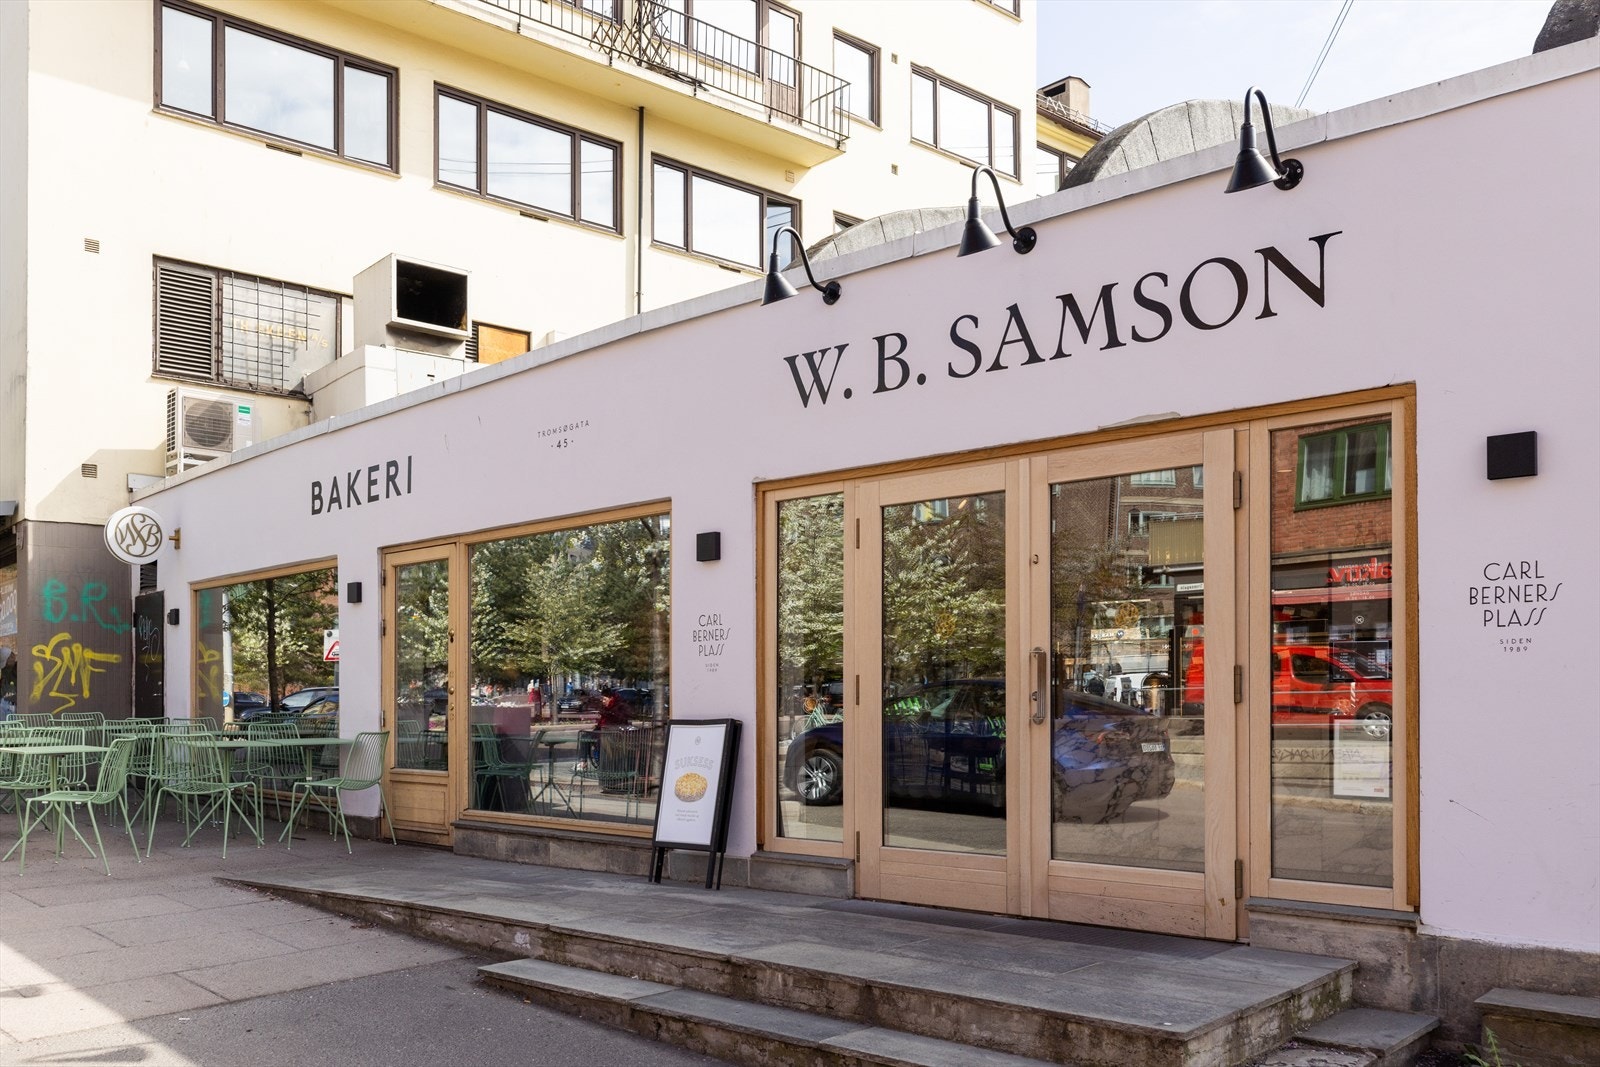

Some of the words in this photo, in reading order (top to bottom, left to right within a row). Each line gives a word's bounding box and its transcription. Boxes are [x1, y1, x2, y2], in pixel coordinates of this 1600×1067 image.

[783, 343, 853, 408] W.
[872, 332, 927, 394] B.
[947, 230, 1343, 379] SAMSON
[537, 419, 590, 438] TROMSØGATA
[311, 455, 413, 516] BAKERI
[1483, 560, 1545, 581] CARL
[1469, 583, 1563, 605] BERNERS
[698, 613, 723, 627] CARL
[1483, 607, 1547, 627] PLASS
[692, 628, 731, 642] BERNERS
[698, 643, 725, 656] PLASS
